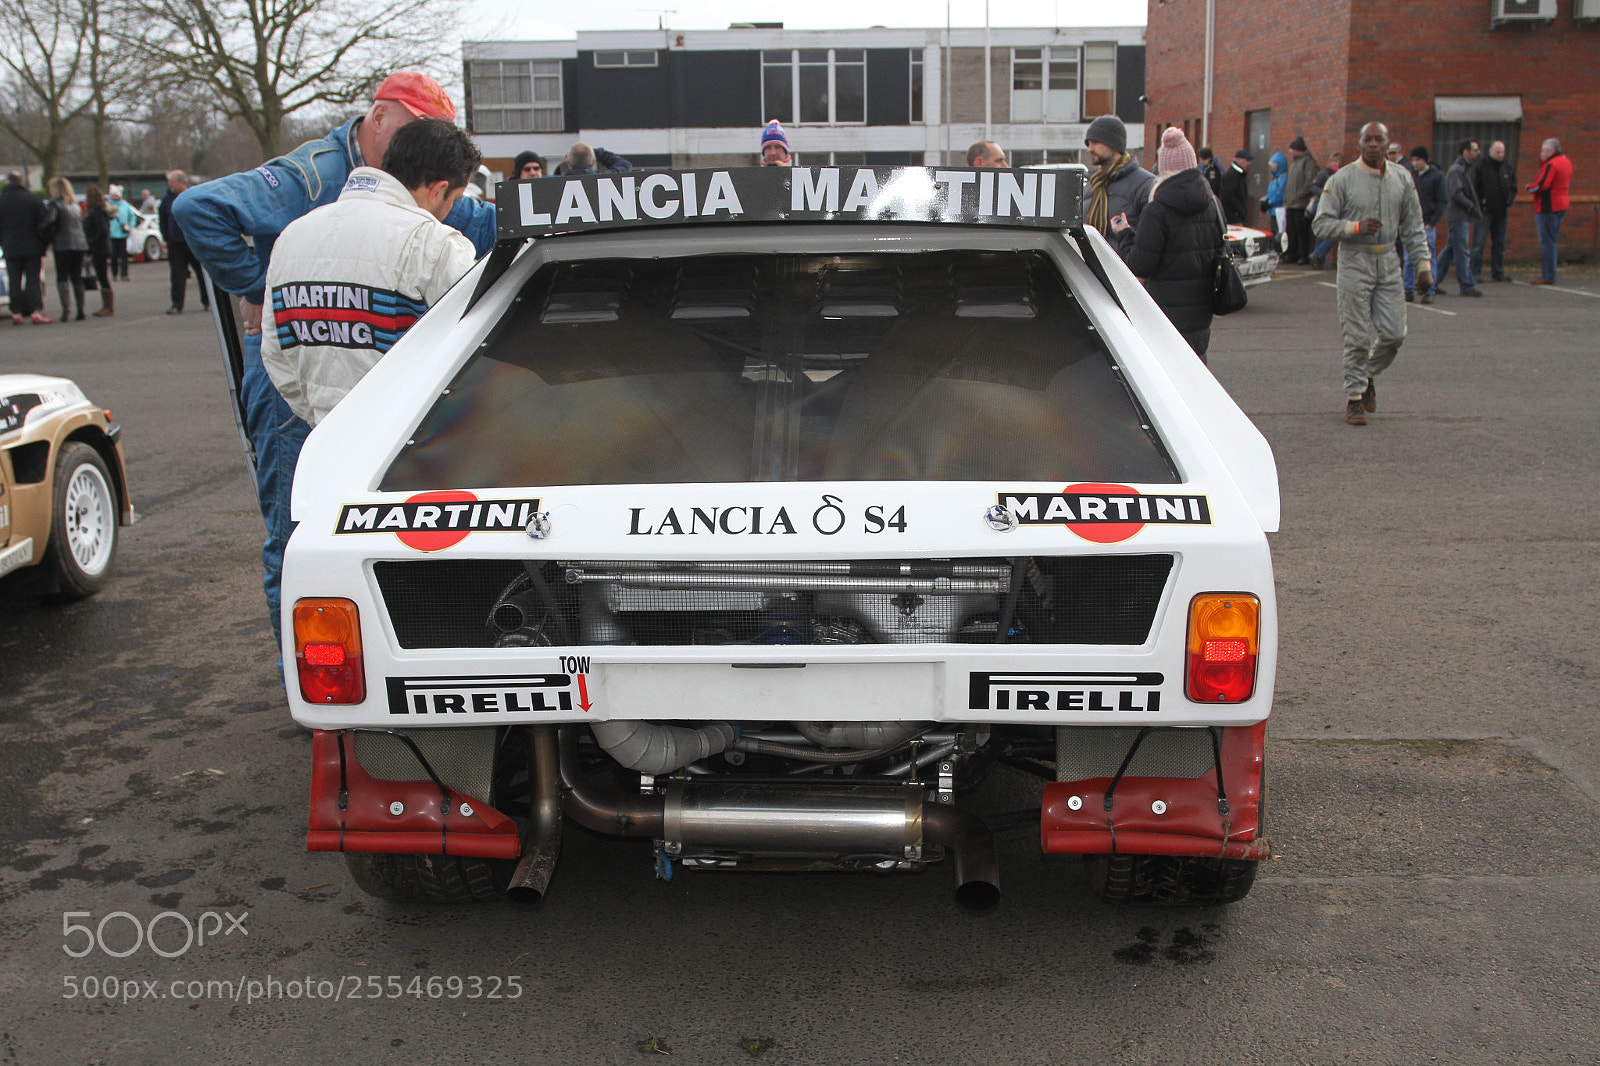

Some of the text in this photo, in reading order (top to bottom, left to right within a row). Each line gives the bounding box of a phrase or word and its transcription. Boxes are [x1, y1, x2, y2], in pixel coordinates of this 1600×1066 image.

[517, 167, 1056, 227] LANCIA MATINI
[281, 285, 370, 311] MARTINI
[343, 503, 531, 531] MARTINI
[626, 506, 798, 536] LANCIA
[864, 505, 908, 534] S4
[1005, 496, 1202, 521] MARTINI
[558, 655, 591, 674] TOW
[385, 673, 573, 714] PIRELLI
[969, 671, 1165, 712] PIRELLI
